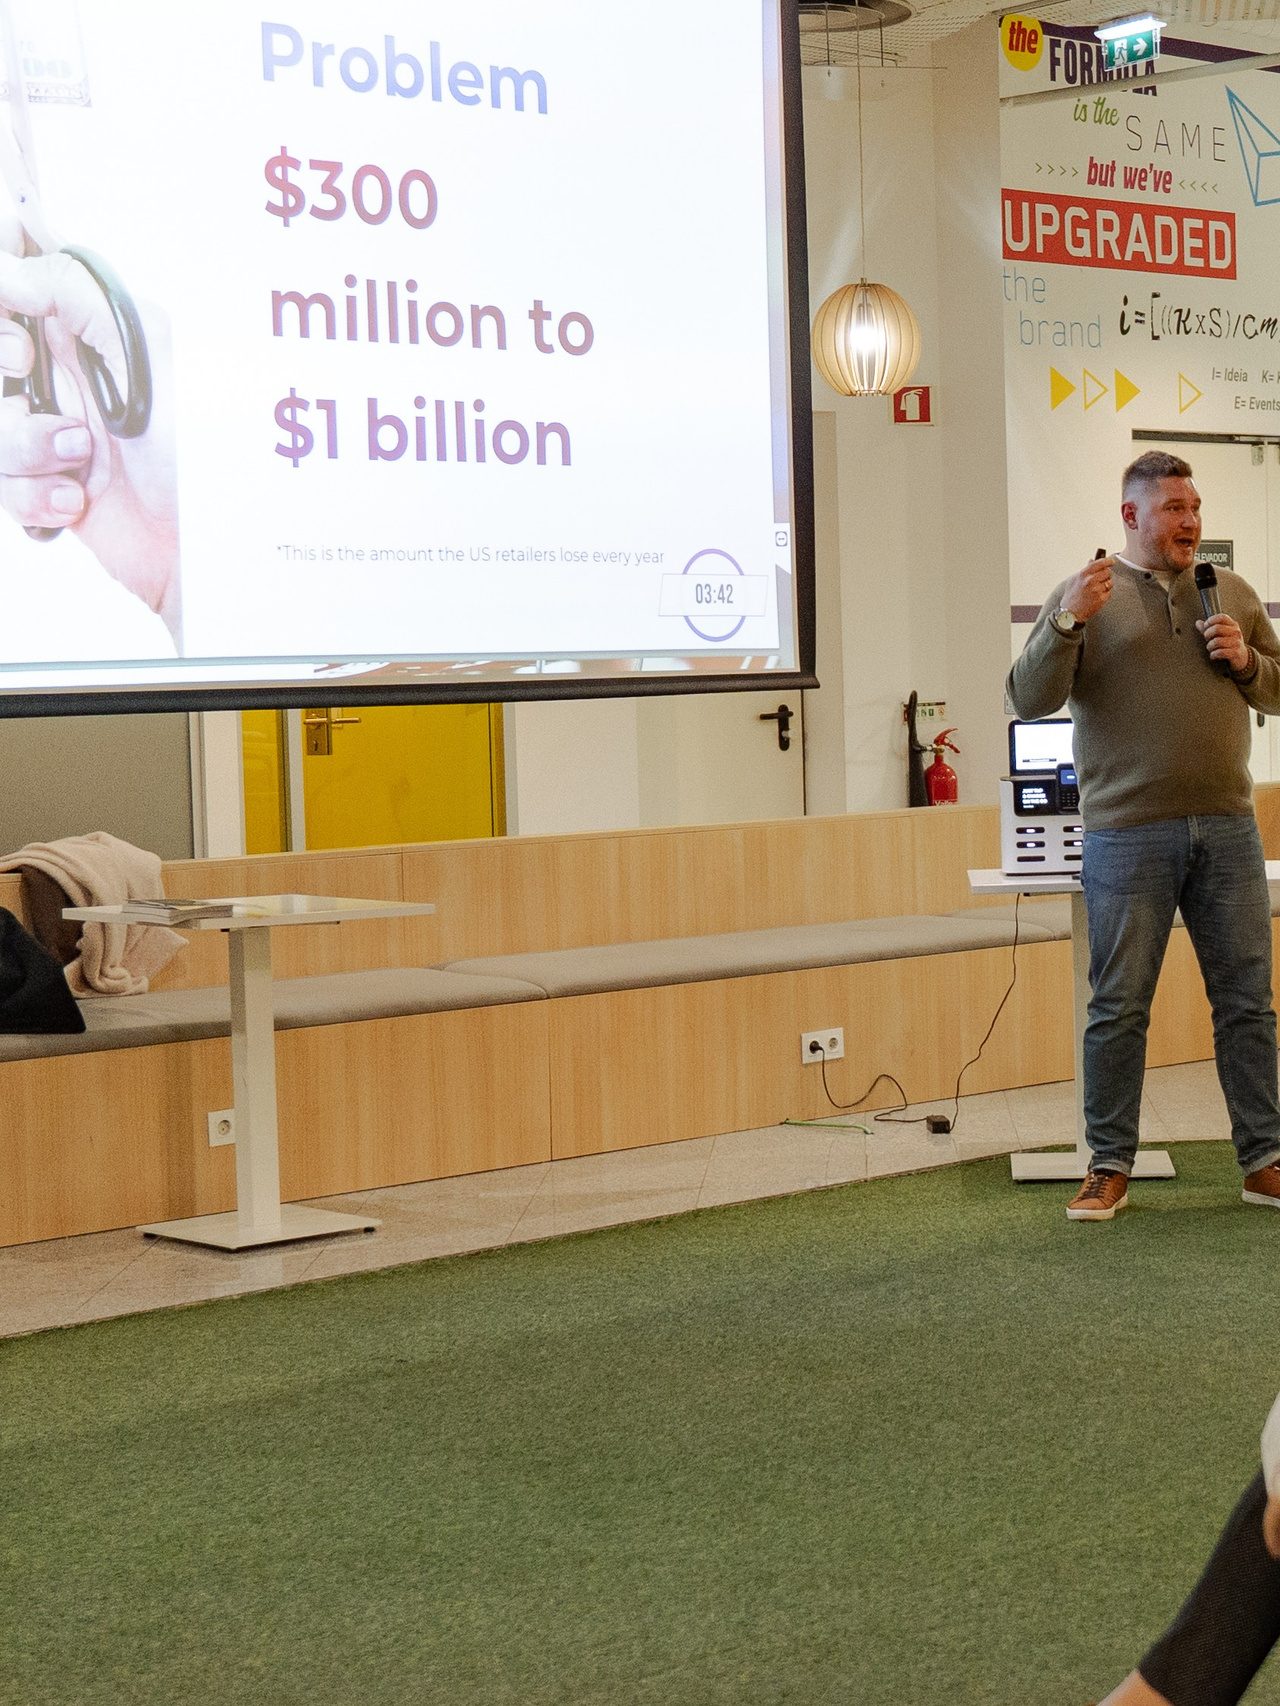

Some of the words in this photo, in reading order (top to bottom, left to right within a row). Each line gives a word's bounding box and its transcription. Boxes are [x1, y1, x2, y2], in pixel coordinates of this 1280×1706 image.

[1008, 21, 1039, 54] the
[260, 21, 549, 116] Problem
[1073, 97, 1088, 123] is
[1093, 96, 1120, 127] the
[1126, 115, 1226, 163] SAME
[264, 146, 438, 229] $300
[1087, 156, 1116, 188] but
[1123, 164, 1173, 194] we've
[1004, 199, 1233, 270] UPGRADED
[1002, 266, 1046, 303] the
[270, 274, 507, 351] million
[529, 300, 595, 357] to
[1019, 310, 1102, 350] brand
[1224, 367, 1249, 382] Ideia
[1249, 397, 1280, 411] Events
[274, 388, 339, 467] $1
[367, 396, 572, 466] billion
[321, 545, 334, 561] is
[338, 546, 365, 561] the
[370, 549, 433, 562] amount
[438, 547, 465, 562] the
[470, 546, 491, 562] US
[495, 547, 556, 563] retailers
[560, 547, 589, 563] lose
[593, 551, 632, 567] every
[635, 551, 665, 567] year
[695, 583, 734, 604] 03:42
